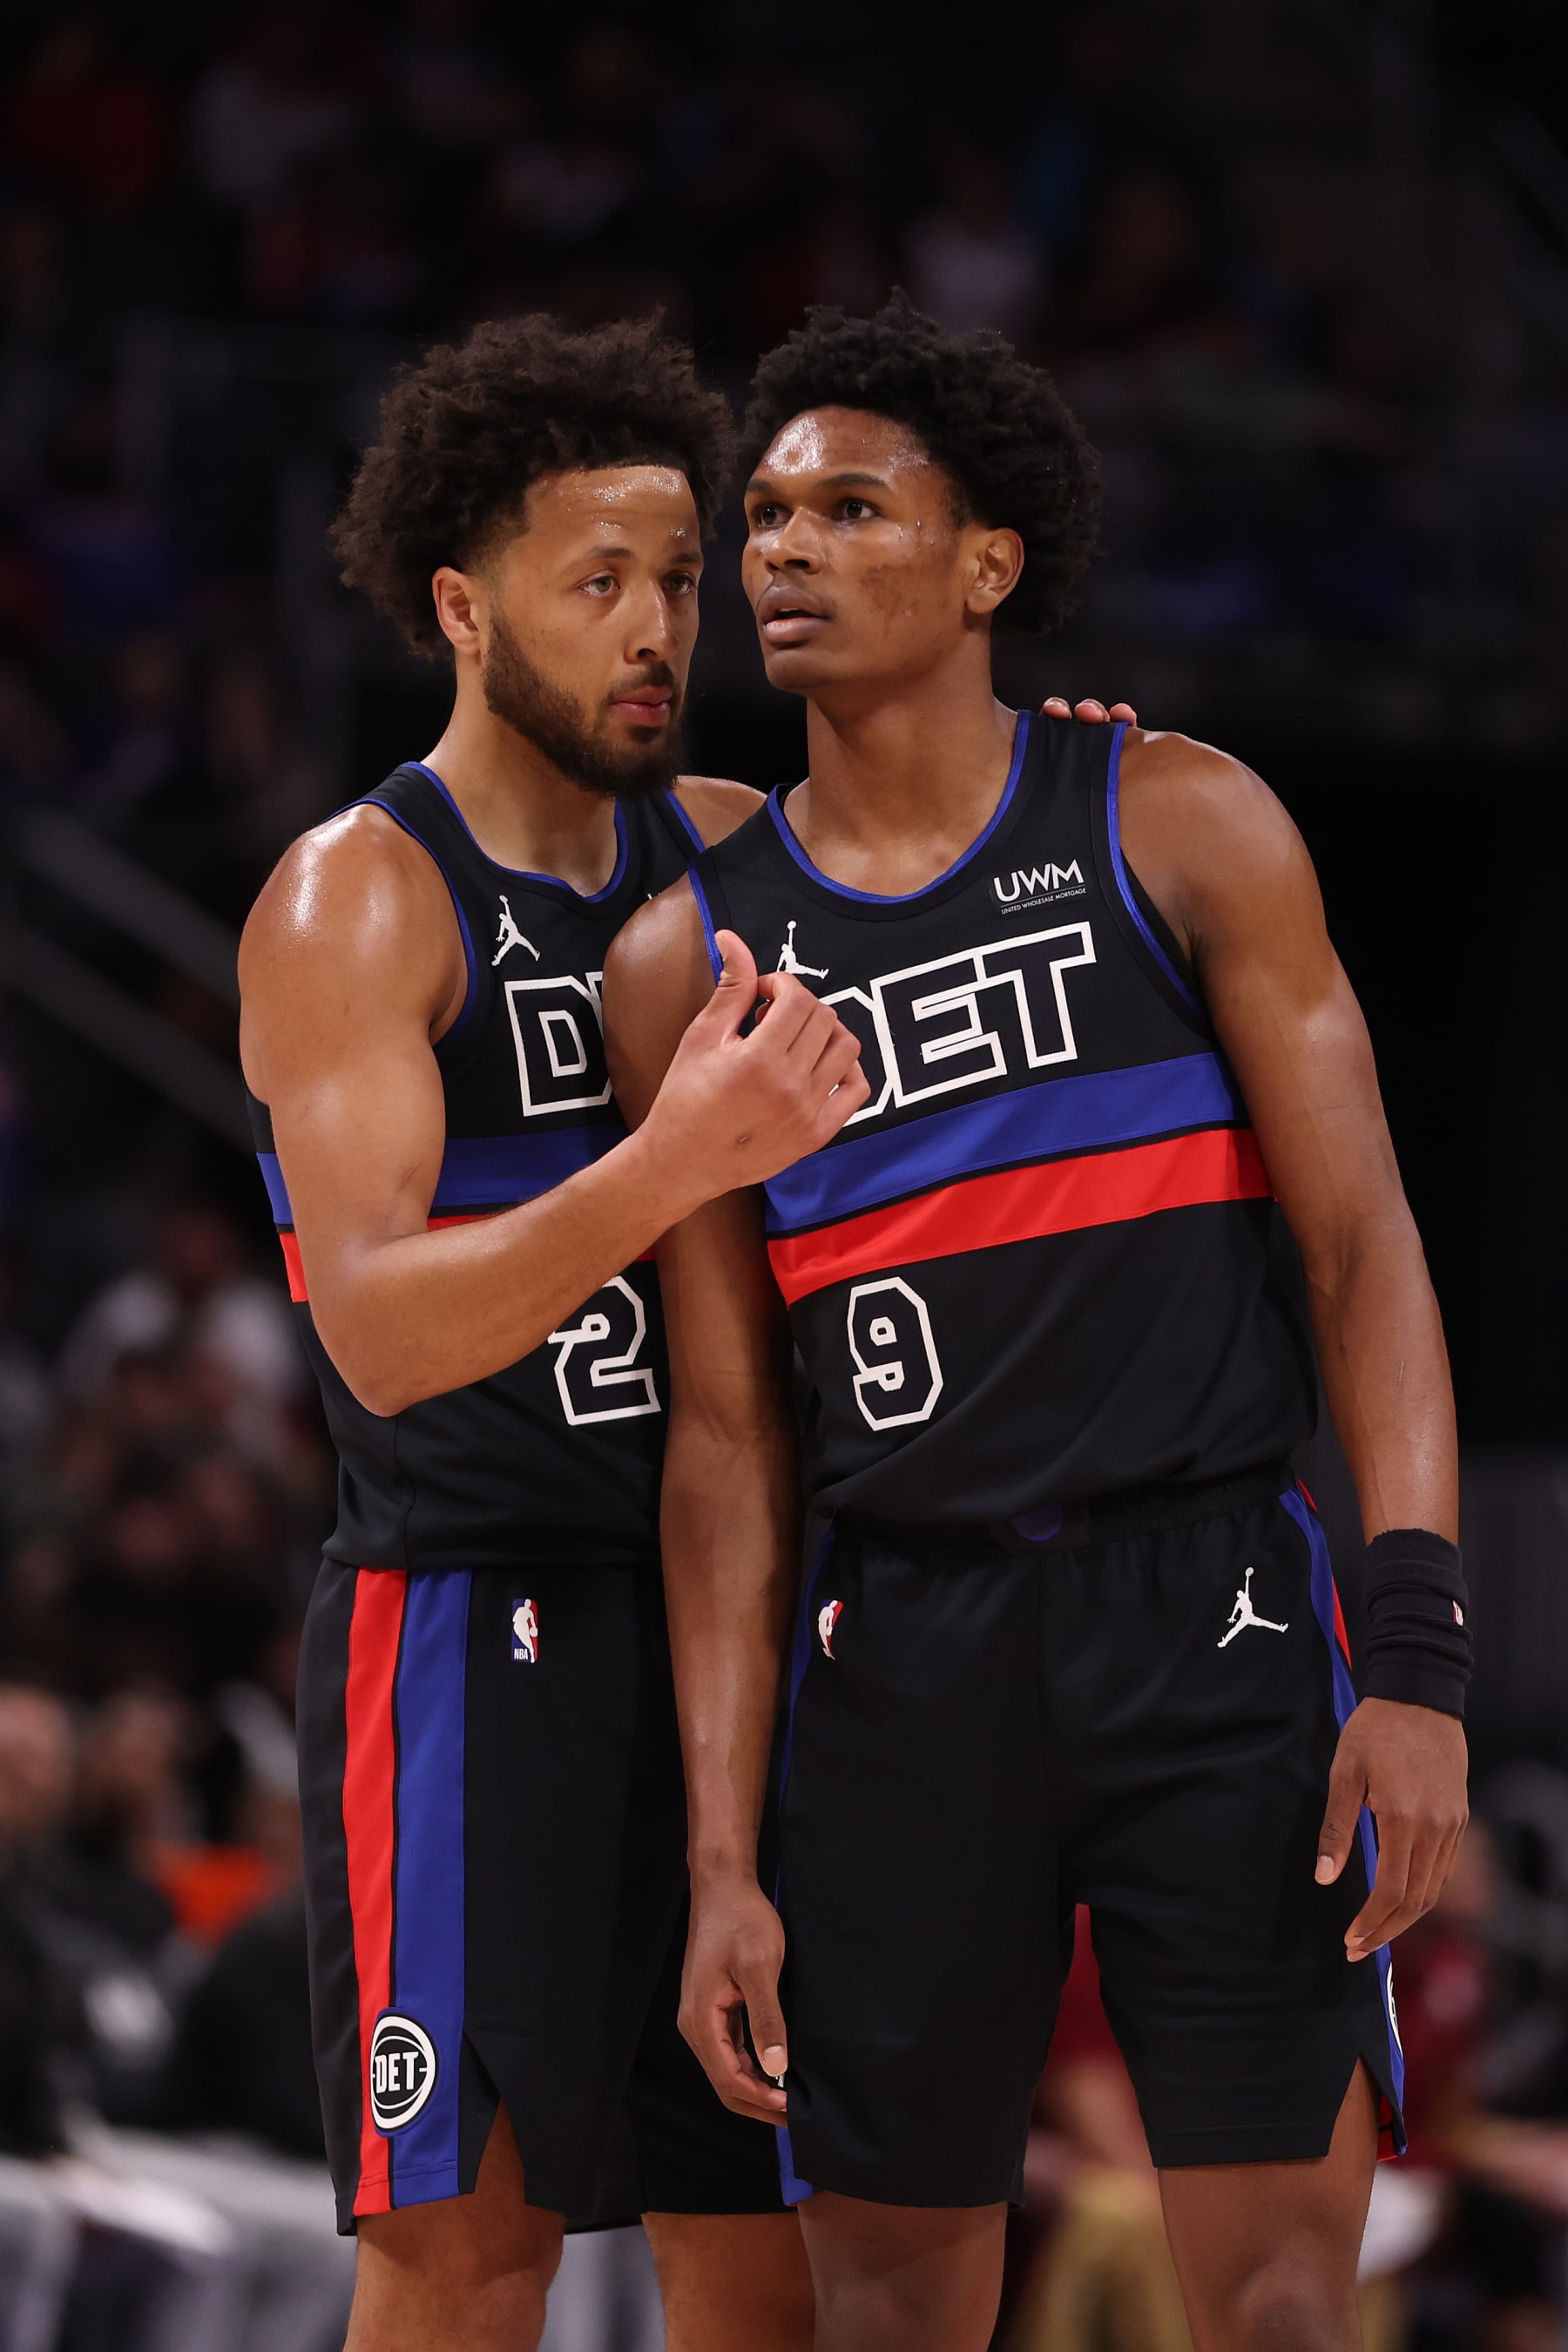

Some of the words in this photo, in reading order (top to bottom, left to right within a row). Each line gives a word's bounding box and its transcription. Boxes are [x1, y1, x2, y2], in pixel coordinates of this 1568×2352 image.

[993, 859, 1085, 902] UWM
[1001, 905, 1022, 915] UNITED
[1021, 895, 1055, 909] WHOLESALE
[1055, 888, 1086, 900] MORTGAGE
[547, 1275, 662, 1426] 2
[847, 1276, 943, 1431] 9
[513, 1647, 529, 1660] NBA
[375, 2051, 419, 2094] DET
